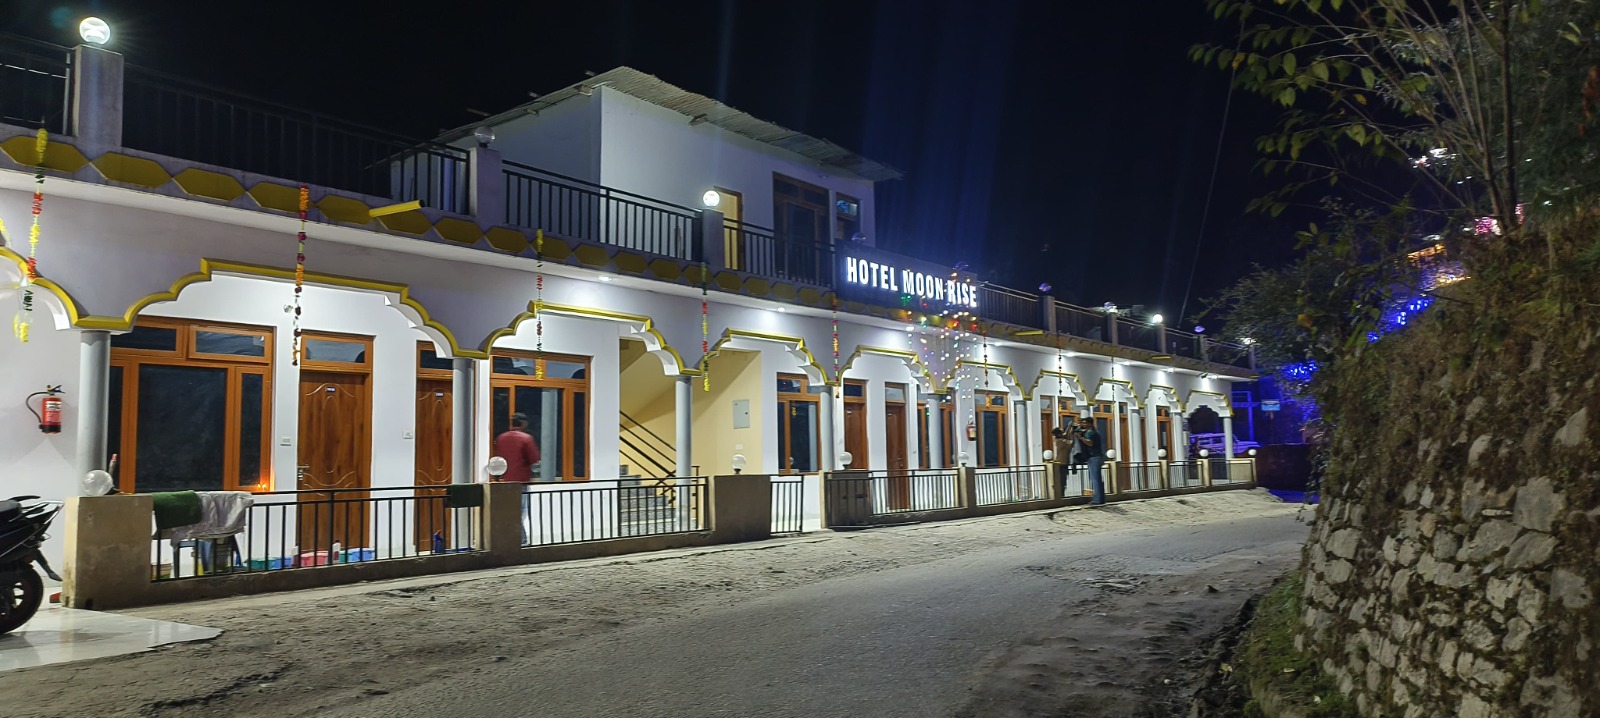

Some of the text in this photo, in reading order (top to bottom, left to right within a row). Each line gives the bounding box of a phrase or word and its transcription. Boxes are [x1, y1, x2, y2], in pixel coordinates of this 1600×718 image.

[847, 256, 977, 308] HOTEL MOON RISE
